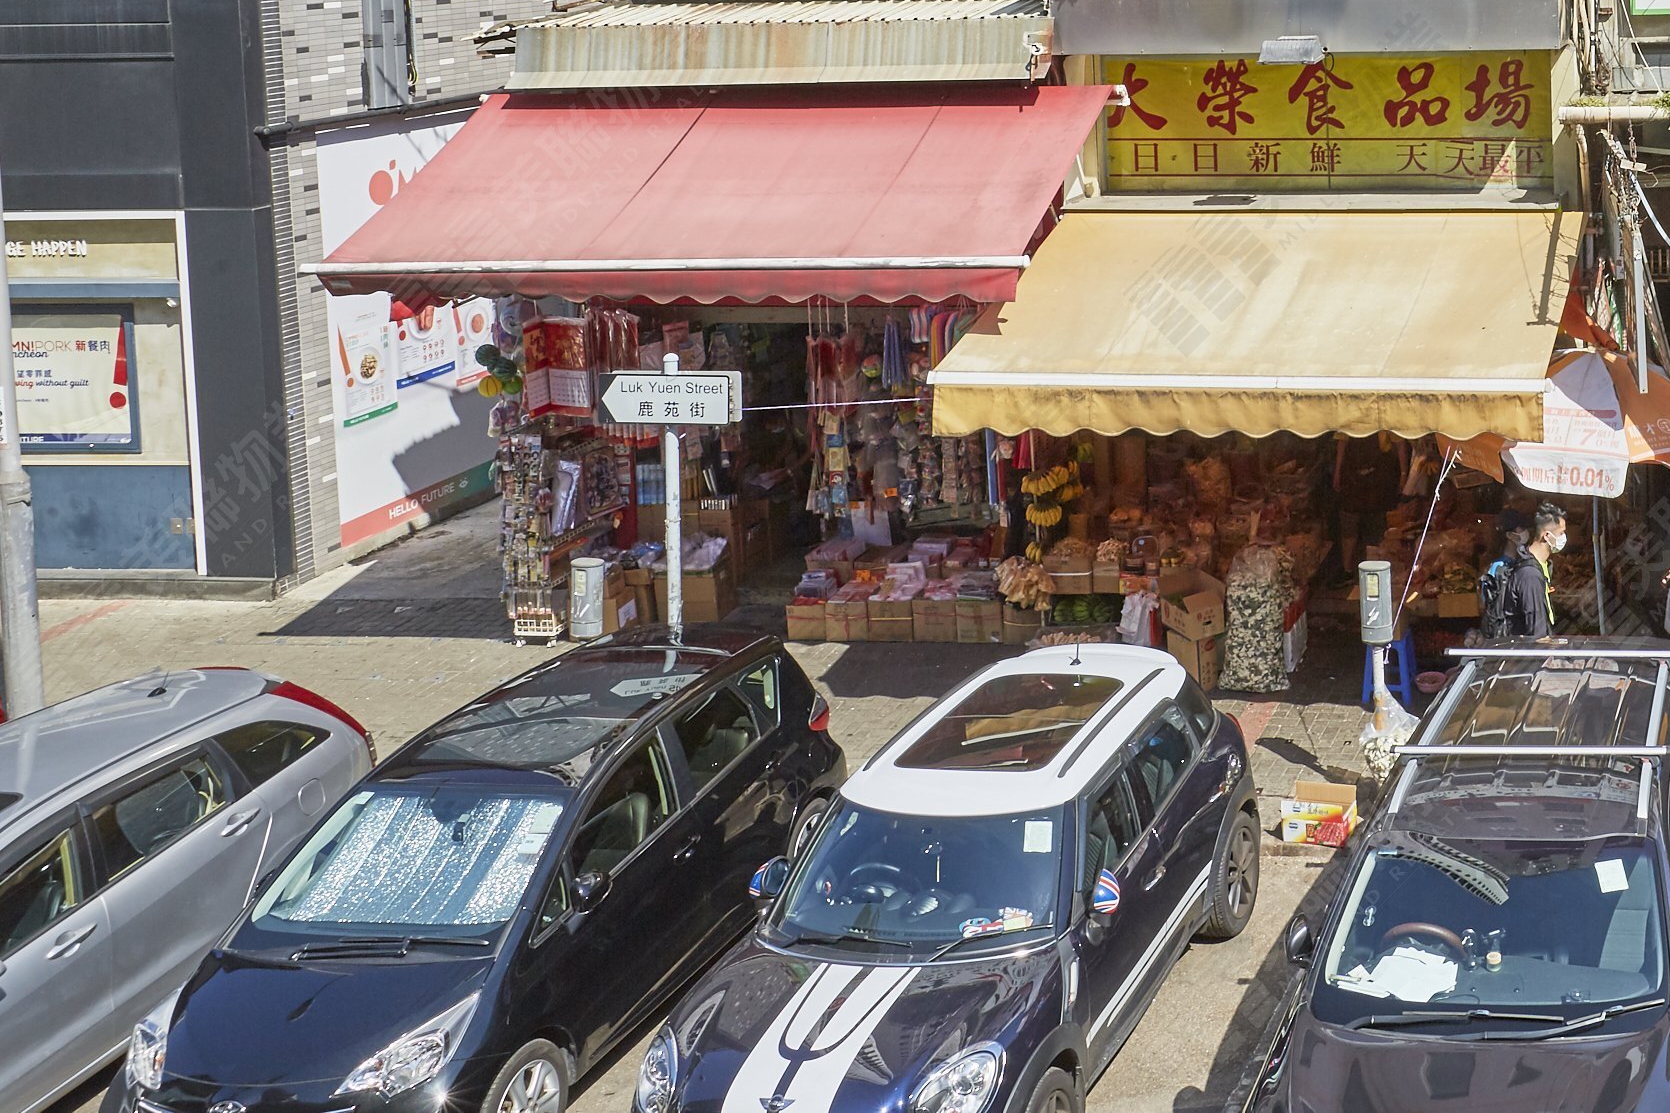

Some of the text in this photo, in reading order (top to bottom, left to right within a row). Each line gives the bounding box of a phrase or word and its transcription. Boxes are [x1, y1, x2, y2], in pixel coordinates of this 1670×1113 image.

[1108, 59, 1535, 135] 大榮食品場
[1133, 141, 1545, 177] 日日新鮮 天天最平
[31, 240, 87, 257] HAPPEN
[75, 340, 110, 353] 新餐肉
[35, 379, 68, 387] without
[69, 379, 89, 389] guilt
[620, 381, 723, 394] Luk Yuen Street
[638, 401, 705, 418] 鹿苑街
[1569, 466, 1615, 492] 0.01%
[388, 482, 455, 520] HELLO FUTURE
